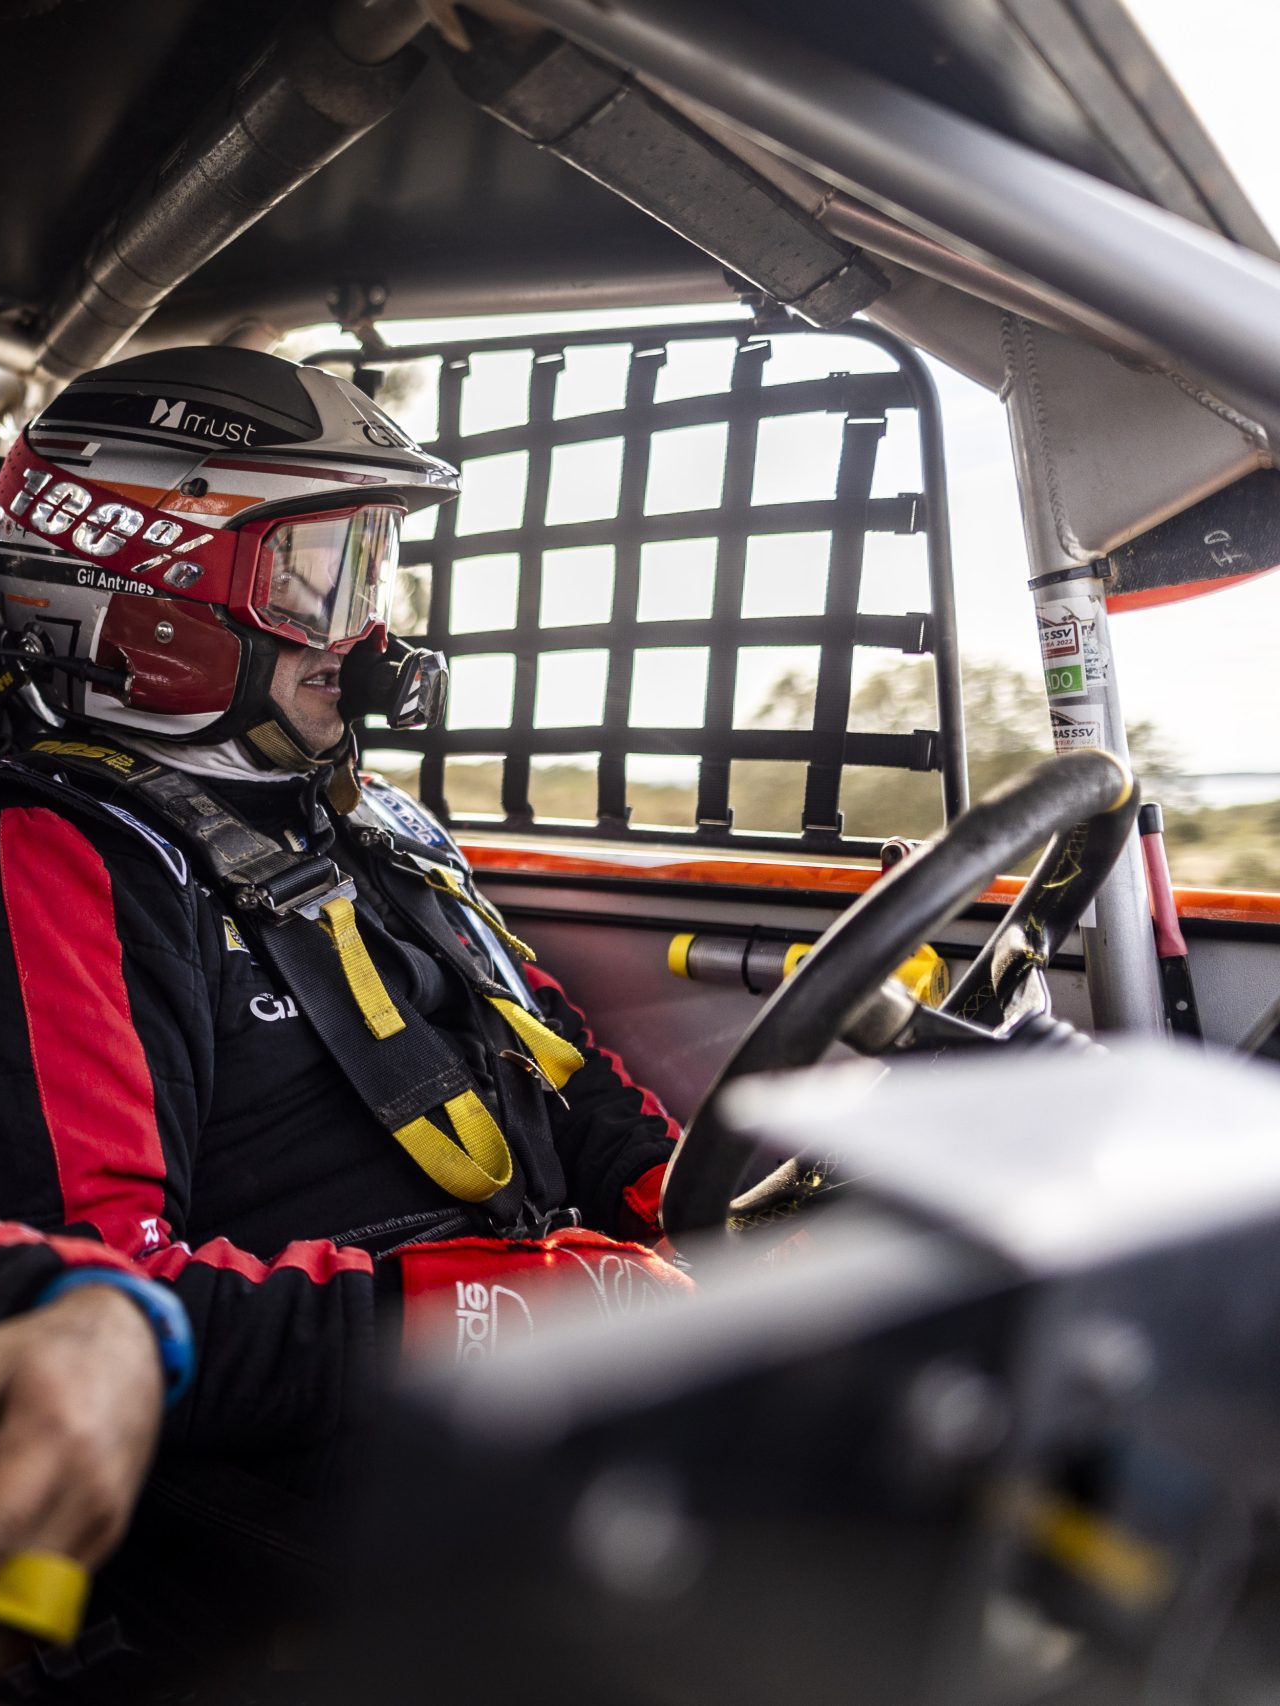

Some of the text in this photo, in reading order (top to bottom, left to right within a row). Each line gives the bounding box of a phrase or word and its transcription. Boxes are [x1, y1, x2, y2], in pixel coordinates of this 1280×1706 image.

[183, 413, 257, 447] must
[9, 467, 215, 590] 100%
[77, 568, 95, 586] Gil
[1050, 628, 1072, 640] SSV
[1070, 728, 1095, 738] SSV
